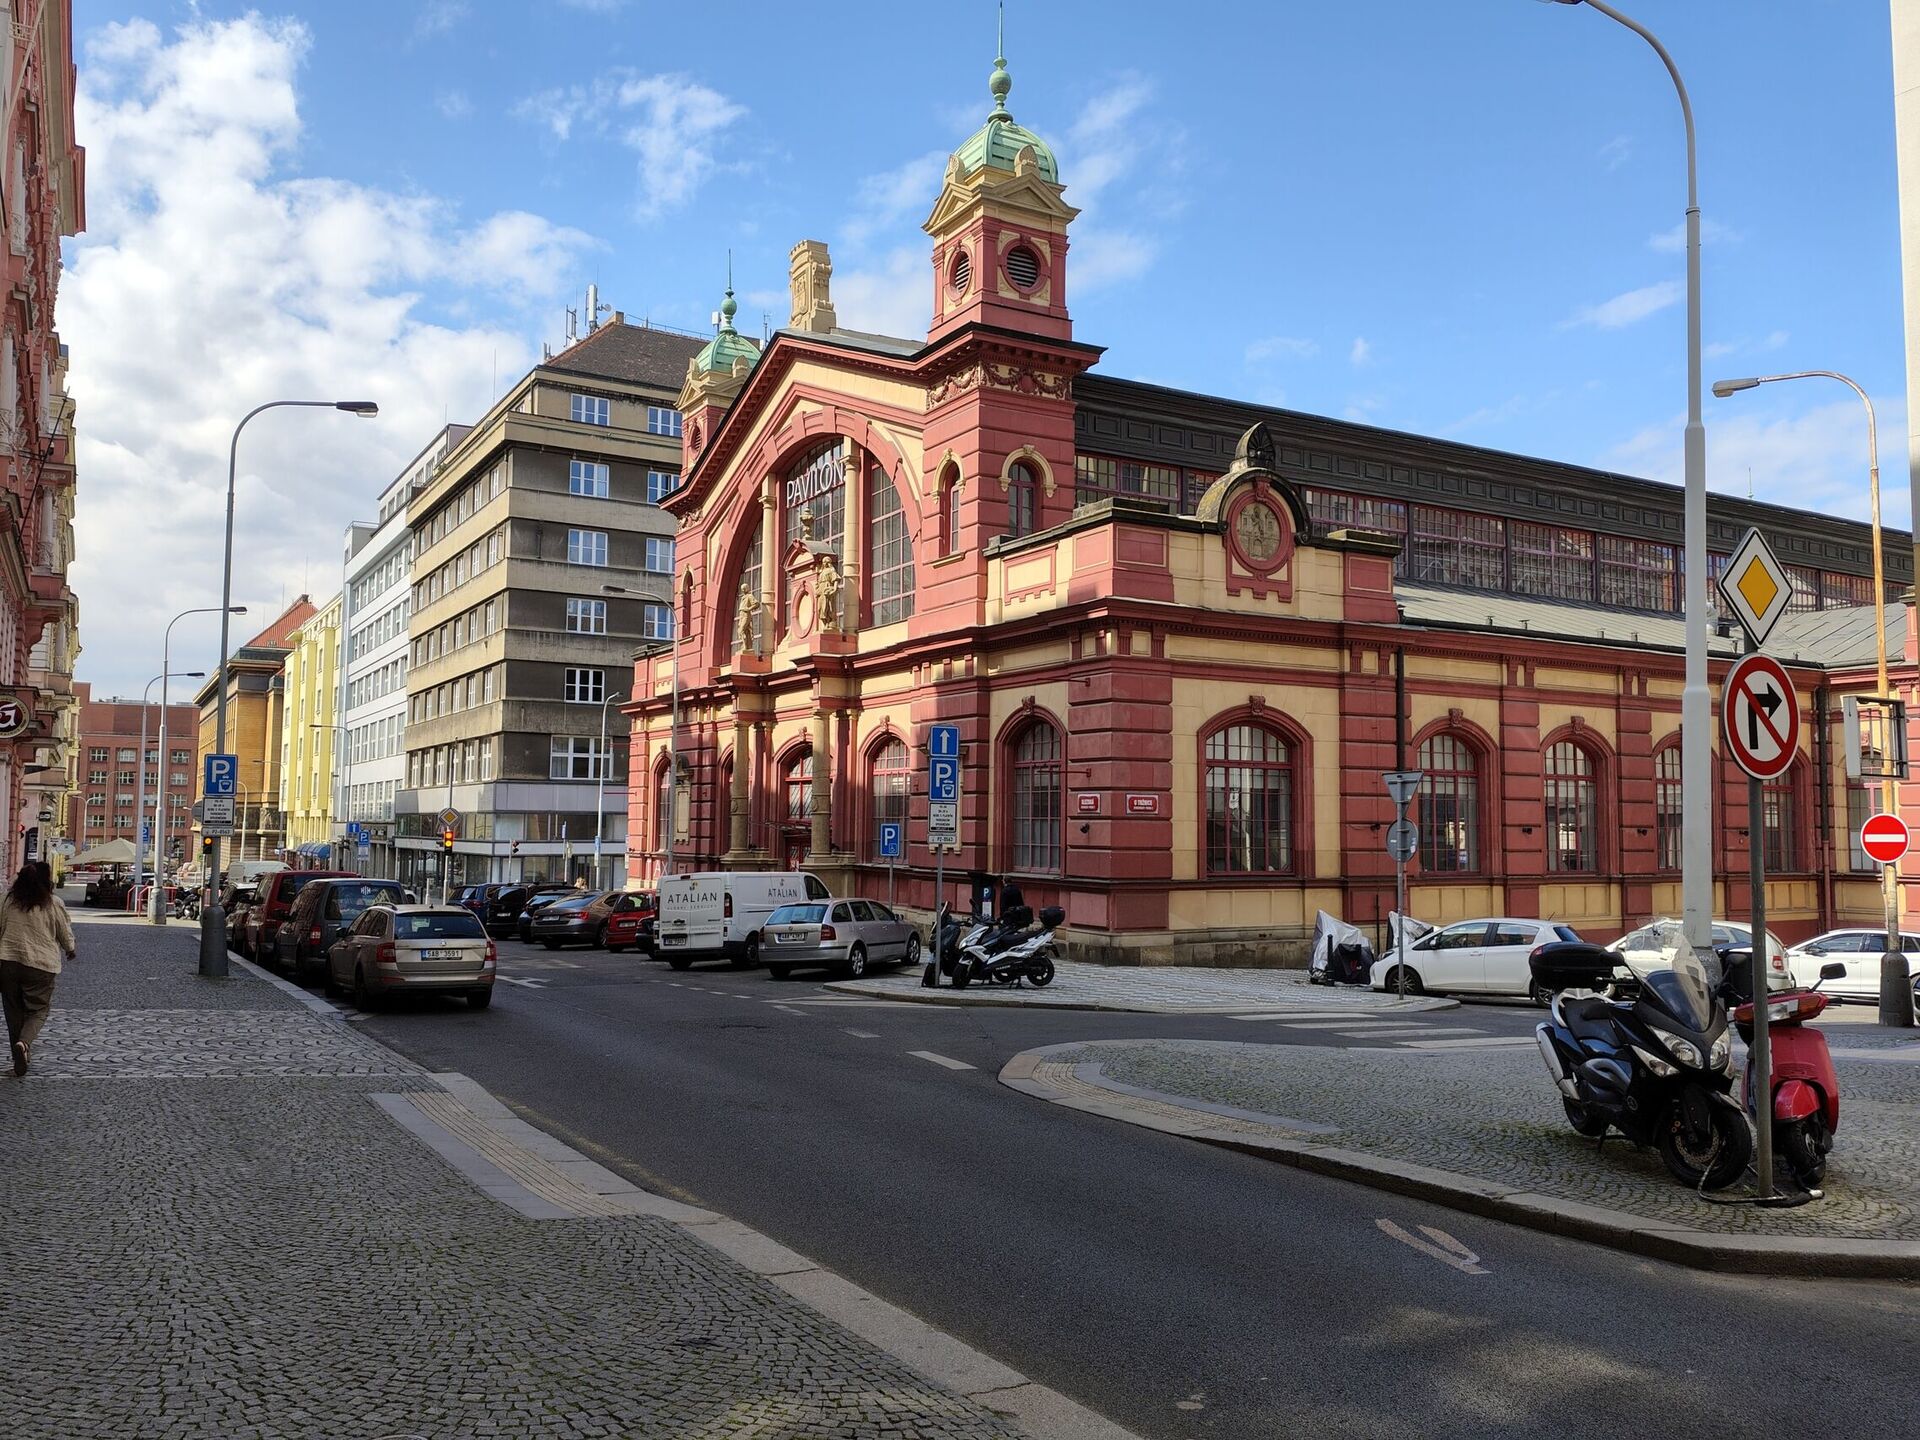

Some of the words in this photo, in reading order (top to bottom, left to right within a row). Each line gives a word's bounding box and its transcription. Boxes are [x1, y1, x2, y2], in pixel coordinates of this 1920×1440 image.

[787, 459, 843, 508] PAVILON
[211, 759, 230, 783] P
[936, 763, 952, 787] P
[360, 832, 368, 842] P
[885, 828, 895, 845] P
[668, 892, 717, 904] ATALIAN
[768, 888, 798, 898] ATALIAN
[984, 888, 990, 897] P
